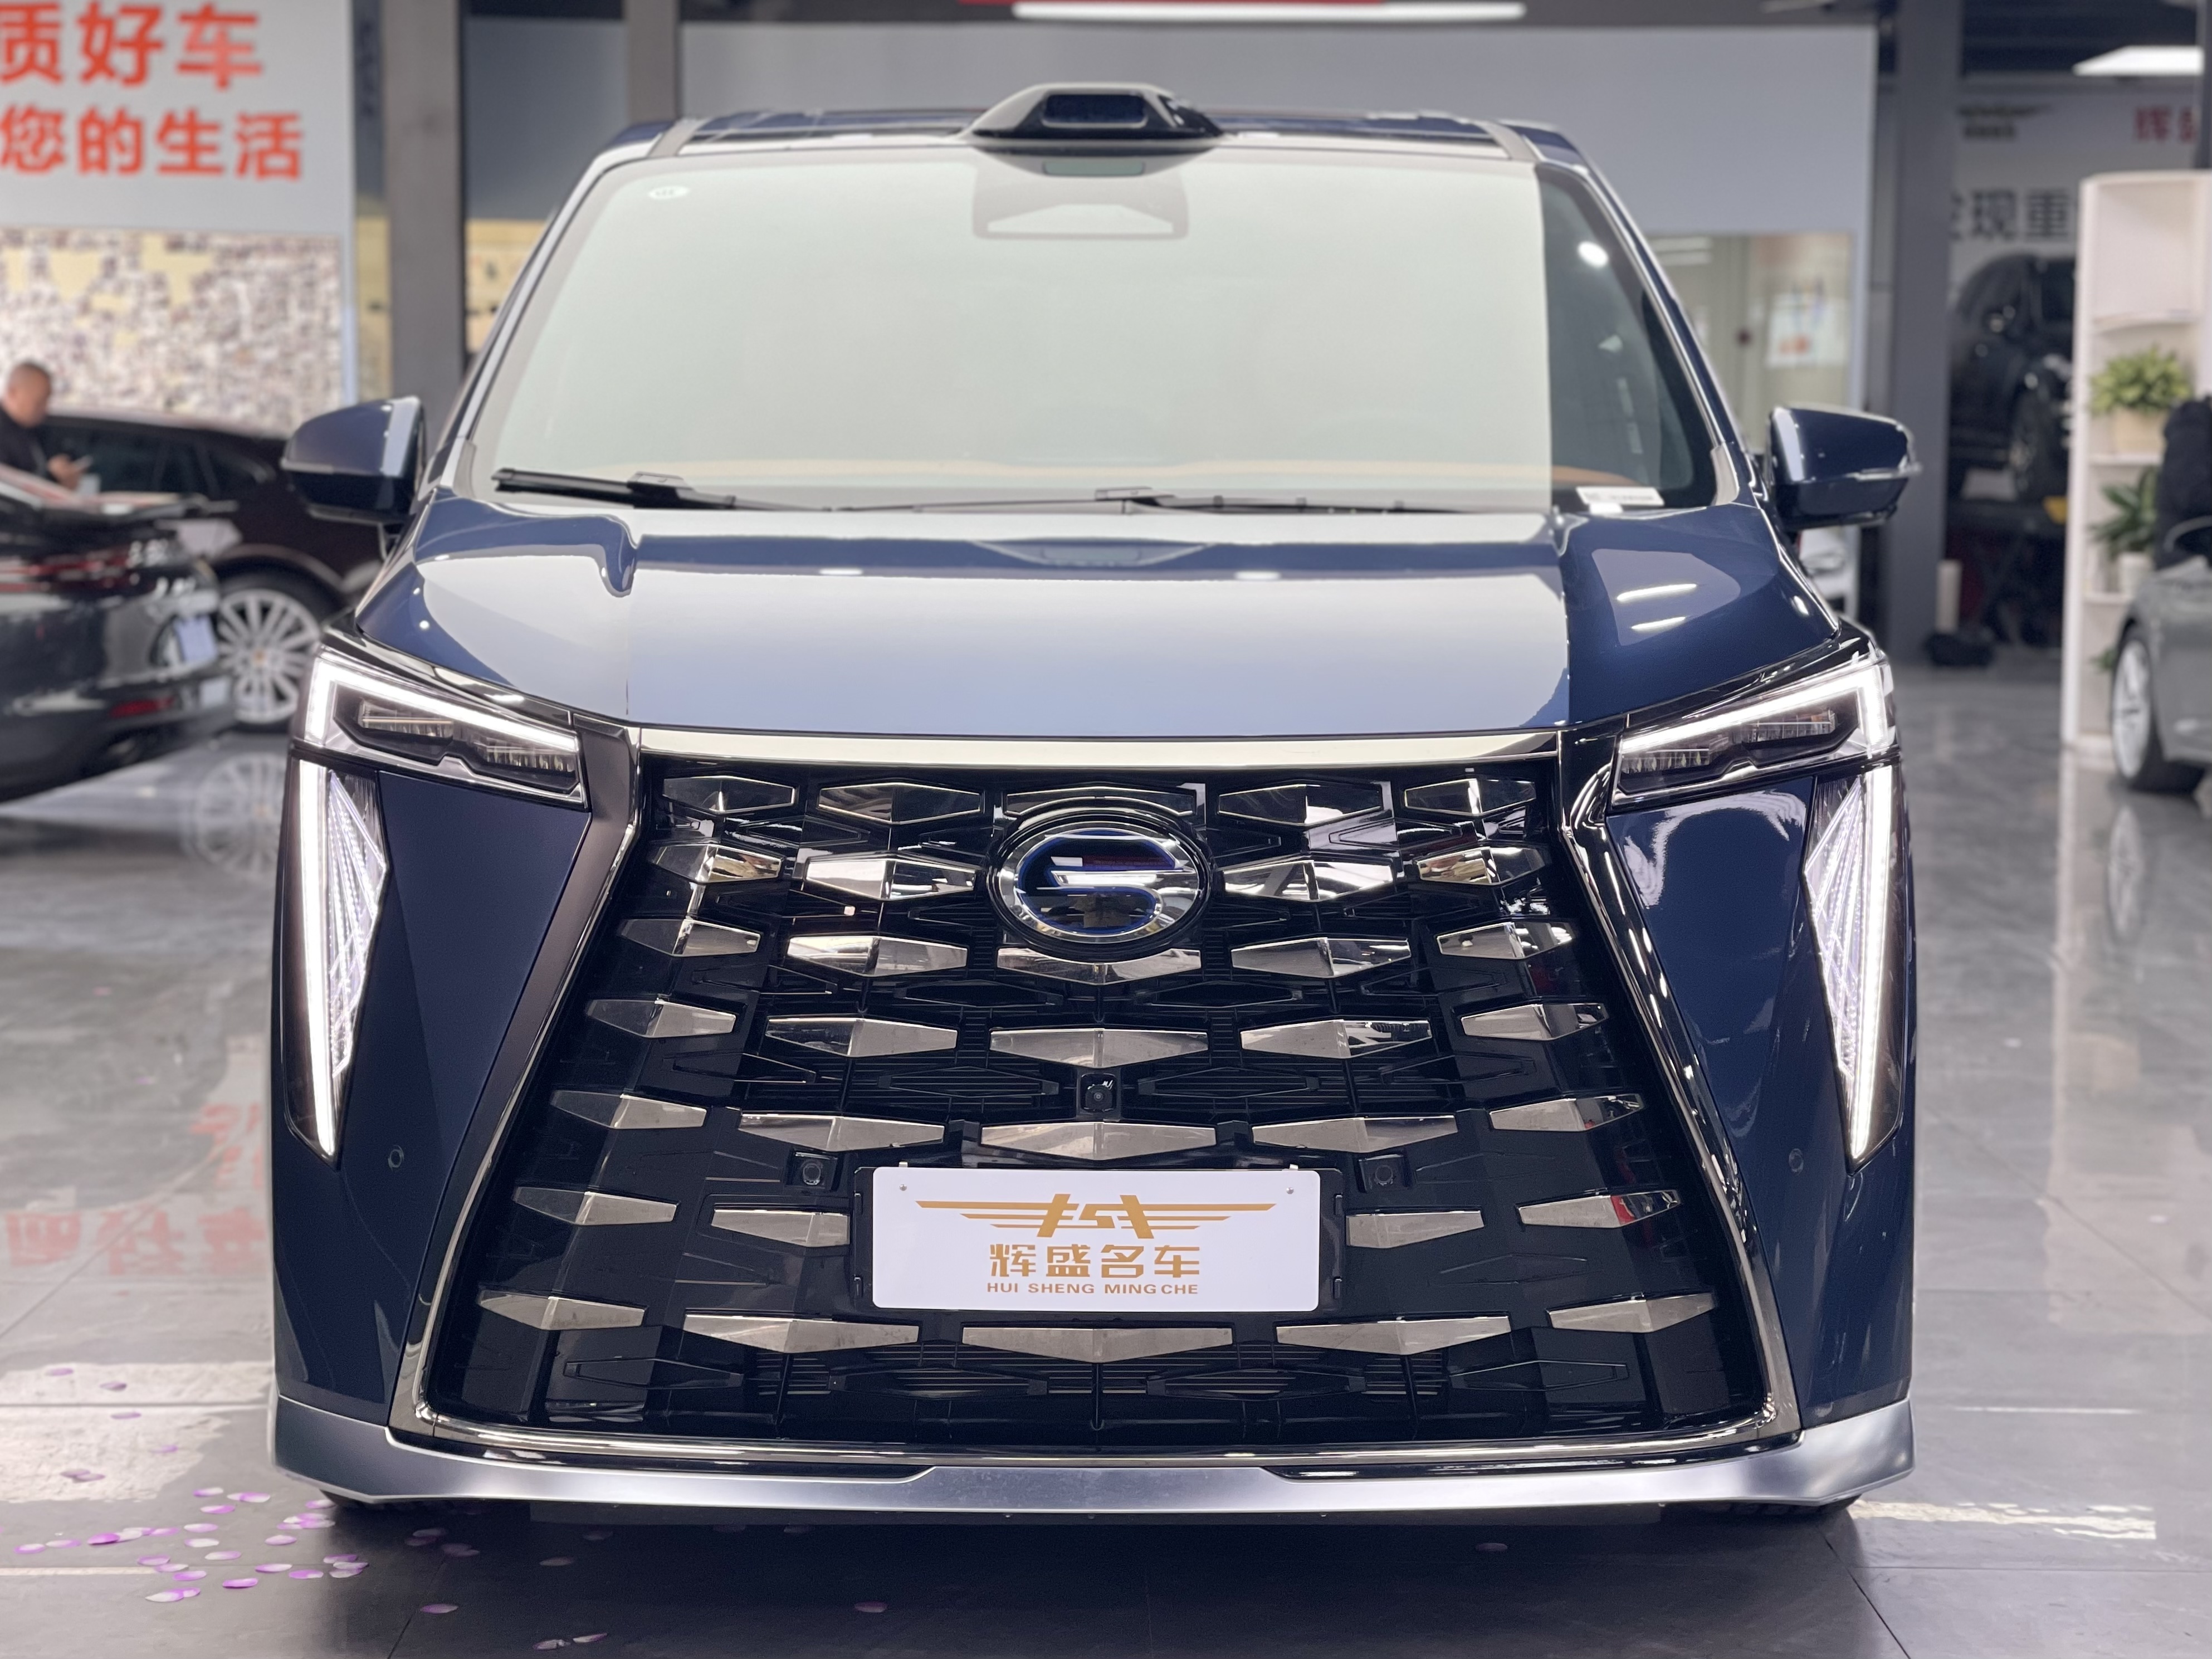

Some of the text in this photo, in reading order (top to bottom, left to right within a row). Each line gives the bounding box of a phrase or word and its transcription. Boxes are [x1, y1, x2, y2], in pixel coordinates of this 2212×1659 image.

[0, 0, 263, 90] 质好车
[0, 105, 302, 180] 您的生活
[989, 1243, 1200, 1279] 辉盛名车
[987, 1283, 1198, 1295] HUI SHENG MING CHE
